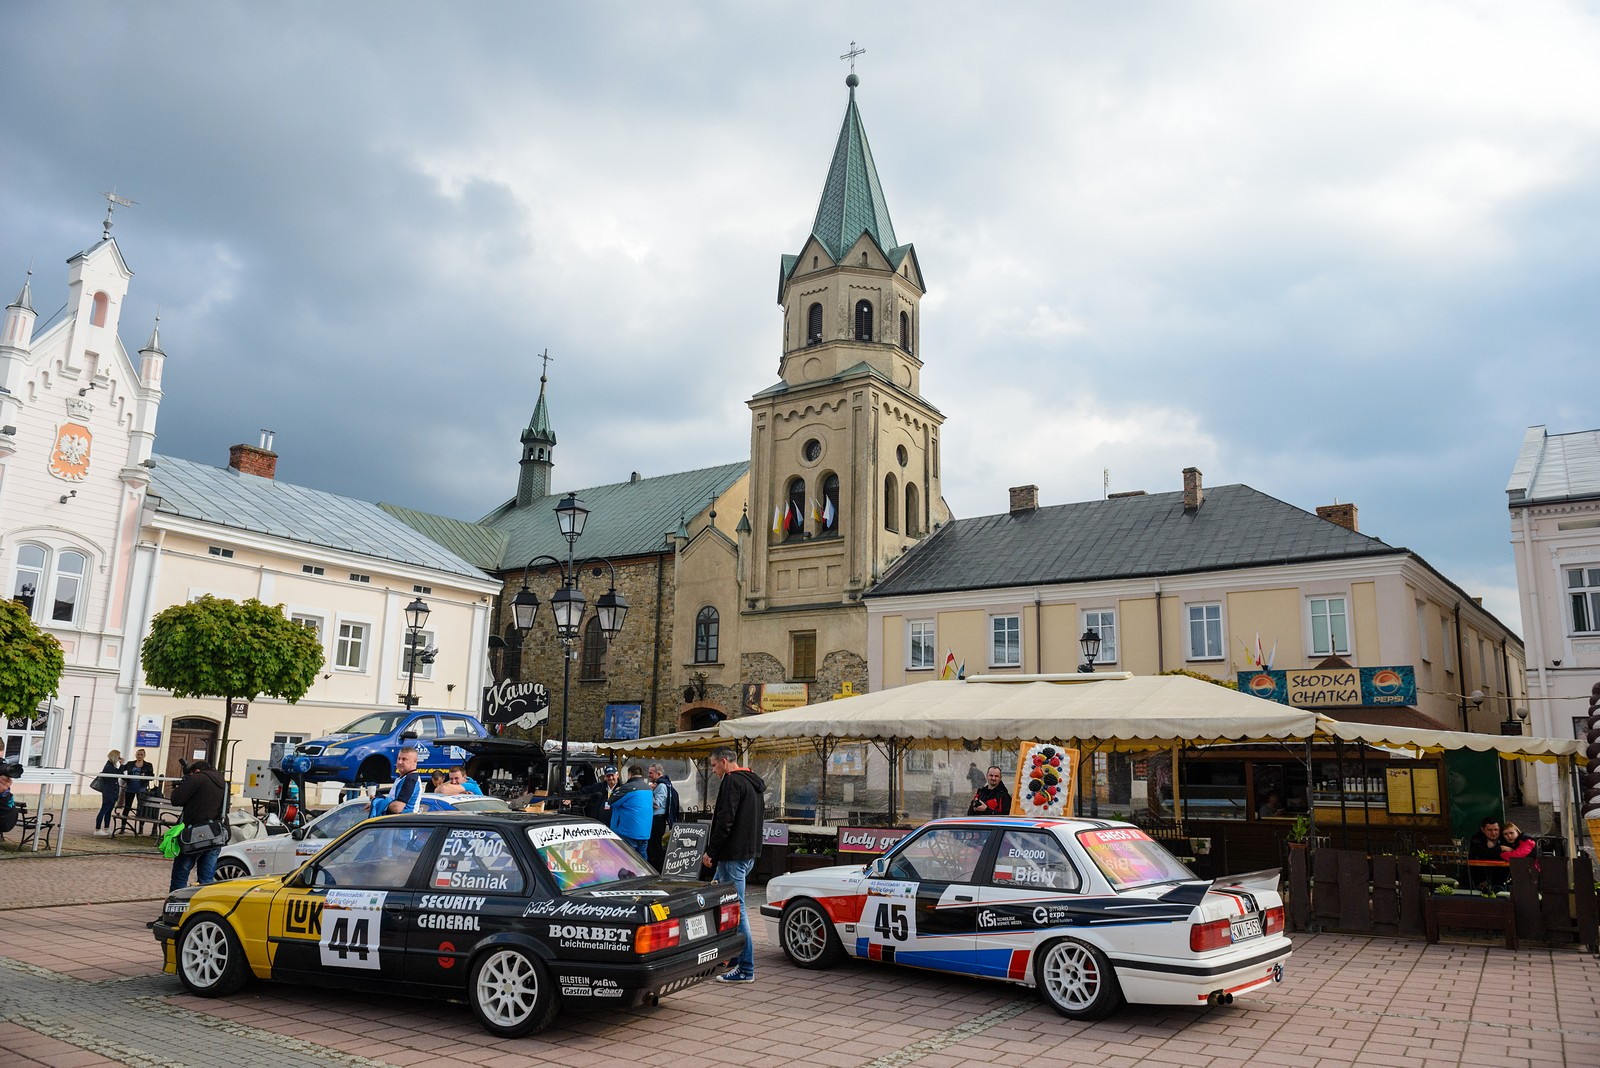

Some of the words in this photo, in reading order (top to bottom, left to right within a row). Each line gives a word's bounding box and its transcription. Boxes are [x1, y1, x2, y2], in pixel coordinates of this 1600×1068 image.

[1292, 673, 1356, 688] SŁODKA
[486, 678, 547, 716] Kawa
[1292, 689, 1359, 704] CHATKA
[1373, 695, 1405, 704] PEPSI
[450, 830, 486, 838] RECARO
[842, 832, 876, 849] lody
[1096, 831, 1132, 841] ENEOS
[450, 872, 508, 890] Staniak
[419, 895, 486, 910] SECURITY
[286, 899, 323, 936] LUK
[417, 914, 481, 931] GENERAL
[874, 903, 909, 942] 45
[328, 917, 370, 961] 44
[549, 925, 632, 942] BORBET
[560, 939, 631, 952] Leichtmetallräder
[697, 948, 719, 964] PIRELLI
[560, 976, 590, 984] BILSTEIN
[563, 988, 590, 996] Castrol
